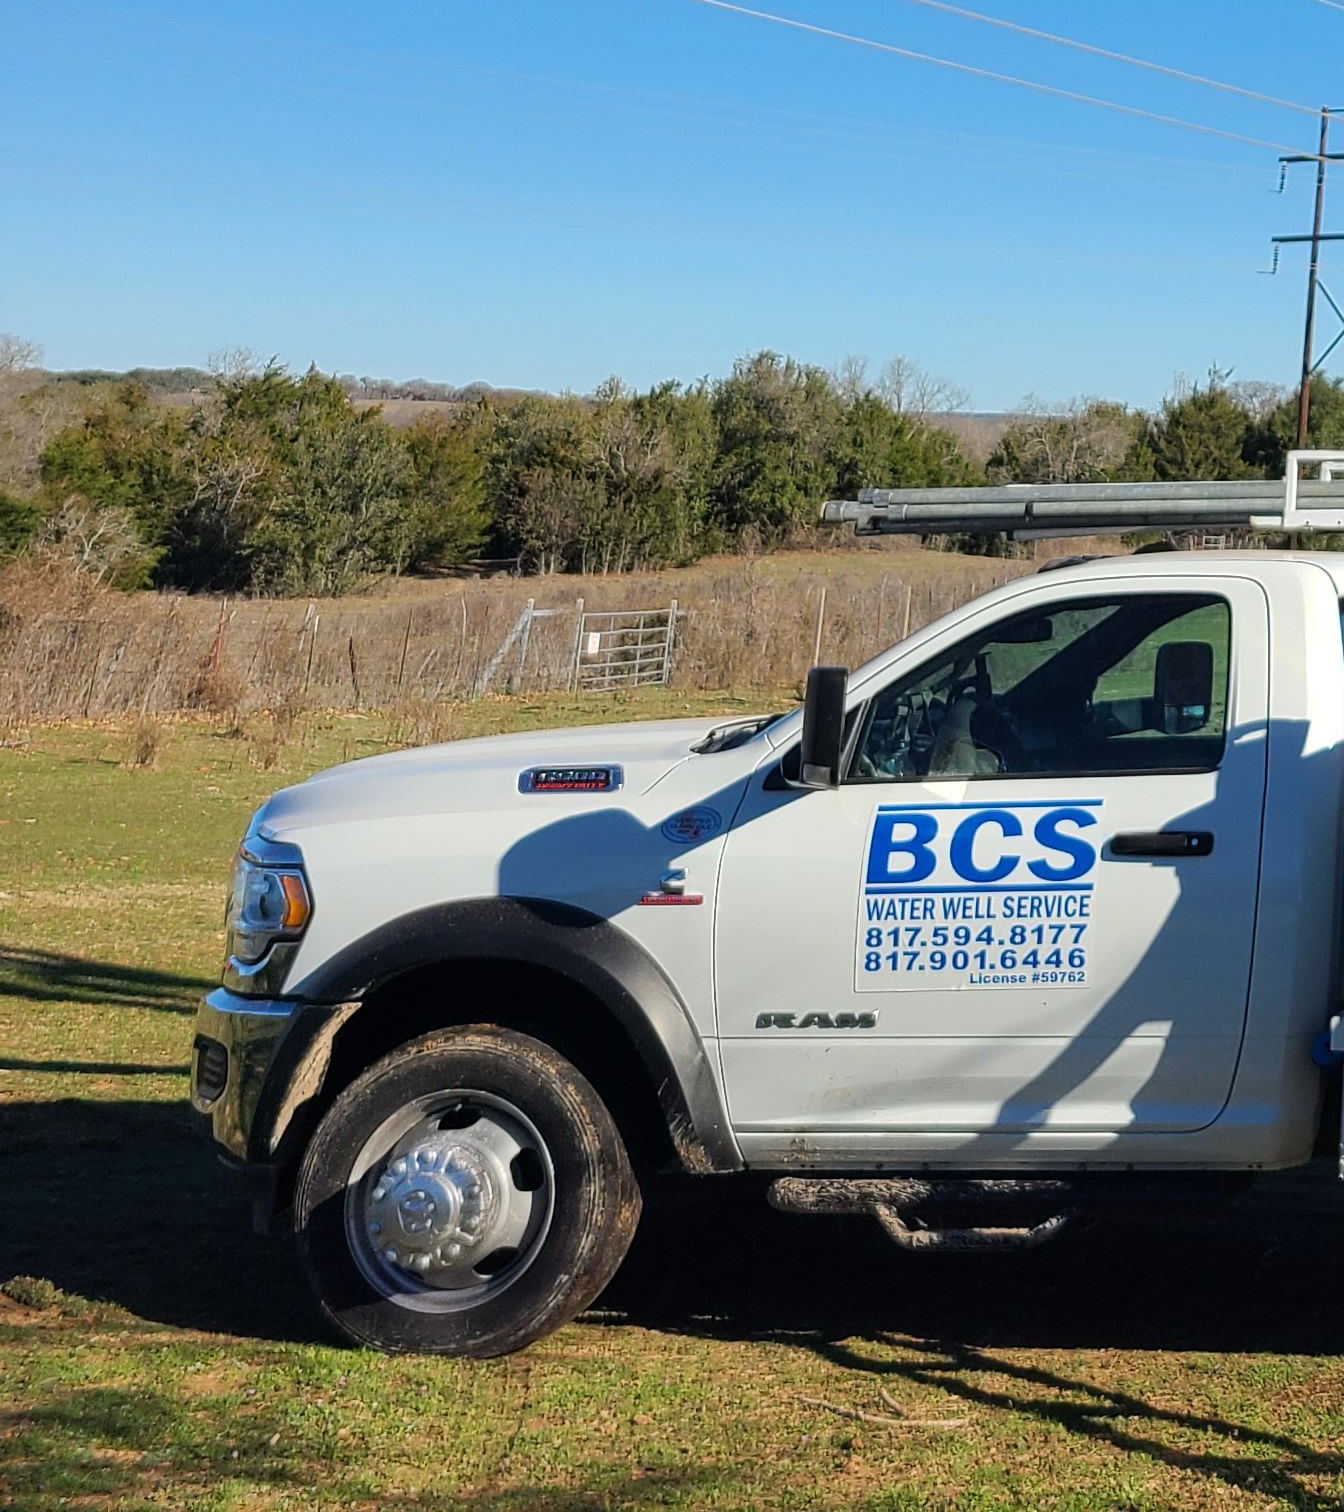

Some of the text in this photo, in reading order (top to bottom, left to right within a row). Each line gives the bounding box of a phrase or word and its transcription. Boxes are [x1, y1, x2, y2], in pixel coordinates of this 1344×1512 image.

[866, 807, 1098, 884] BCS
[866, 894, 1092, 921] WATER WELL SERVICE
[865, 923, 1088, 948] 817.594.8177
[864, 947, 1086, 972] 817.901.6446
[969, 970, 1086, 984] License #59762
[754, 1010, 879, 1029] RAM
